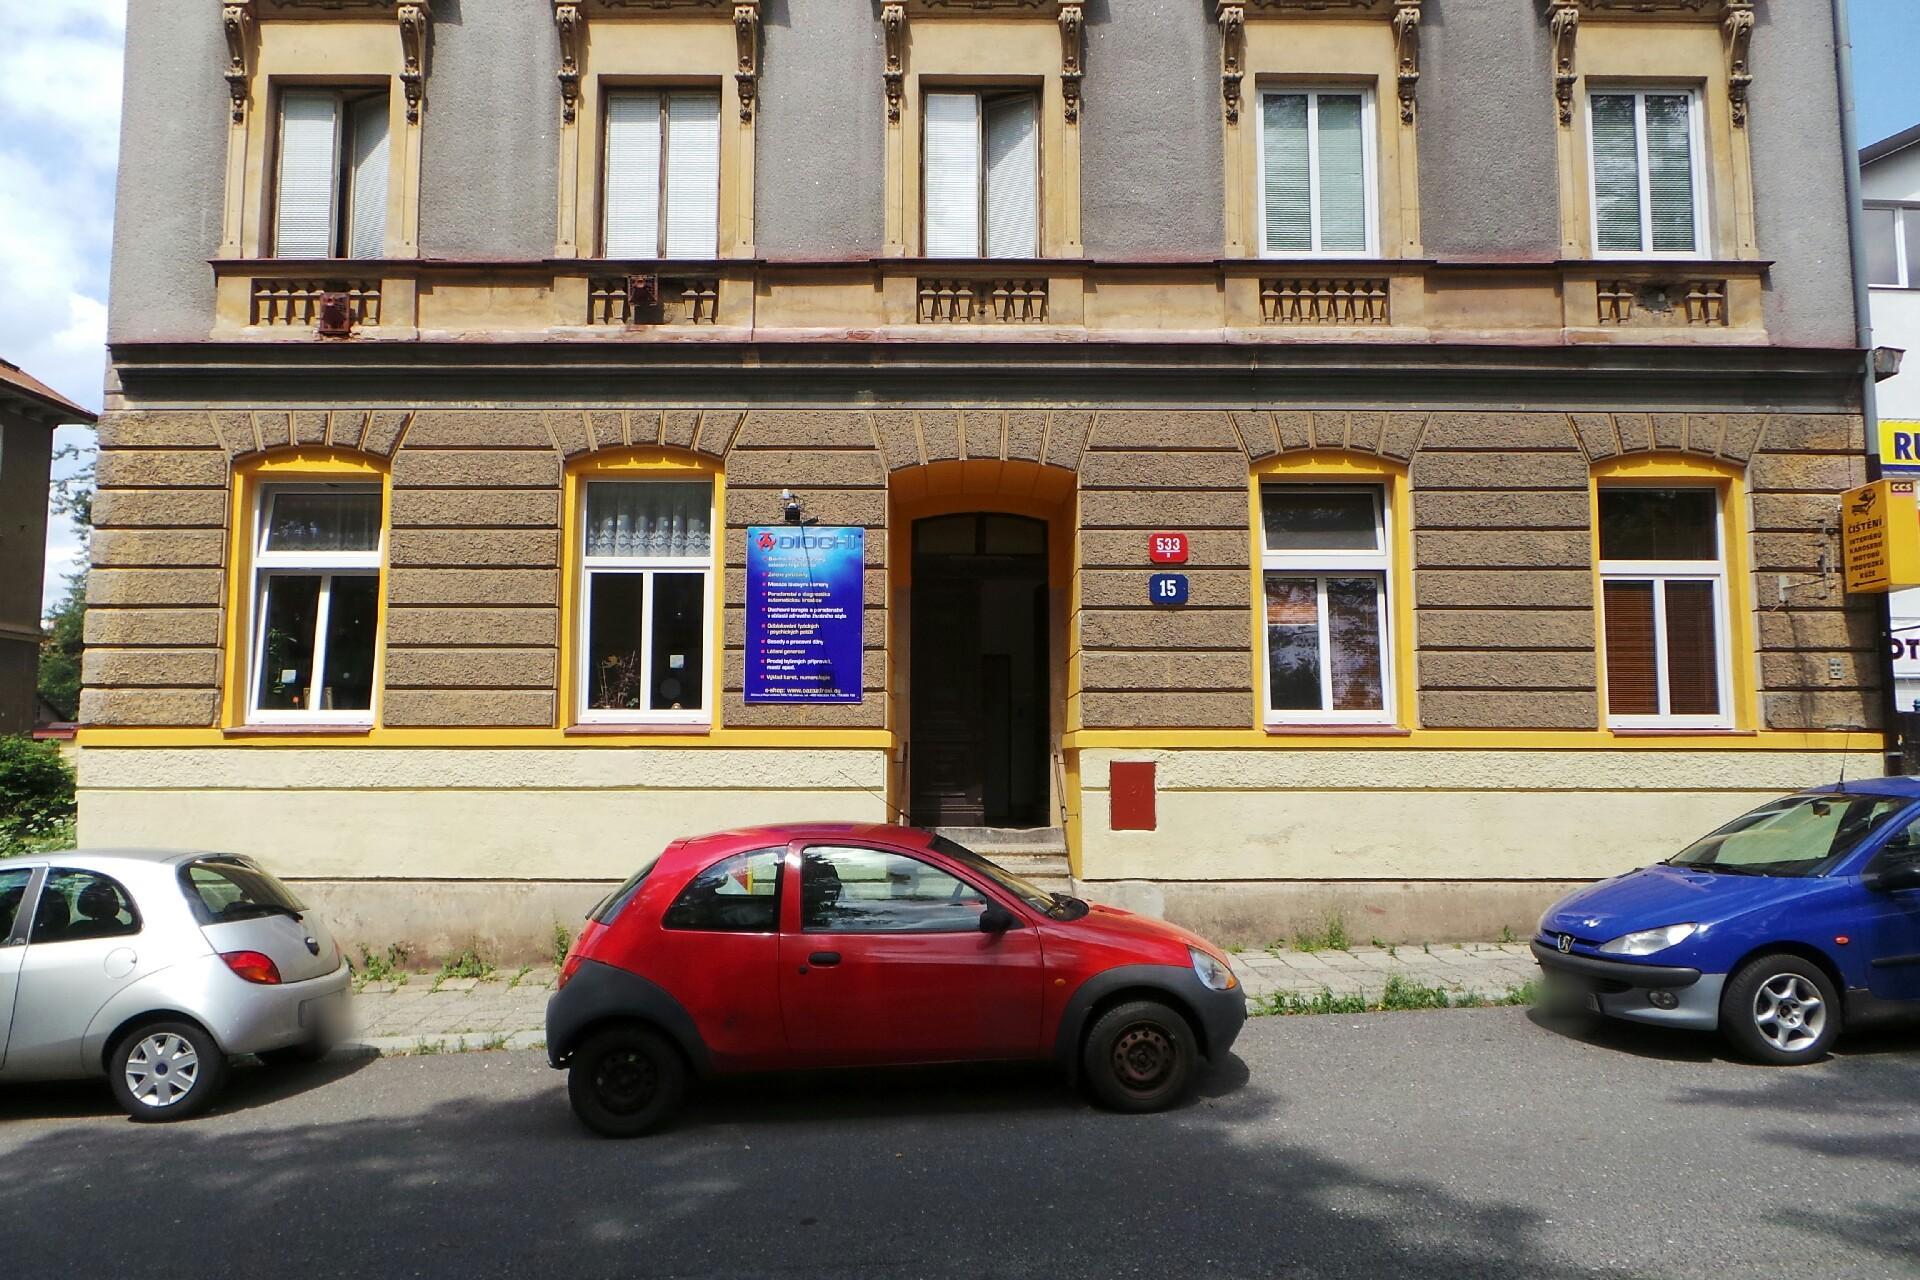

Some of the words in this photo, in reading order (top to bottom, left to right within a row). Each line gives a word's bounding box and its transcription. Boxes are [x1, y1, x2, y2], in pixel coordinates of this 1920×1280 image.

[1892, 483, 1912, 491] CCS
[779, 535, 856, 549] DIOCHI
[1156, 537, 1180, 551] 533
[1159, 579, 1176, 597] 15
